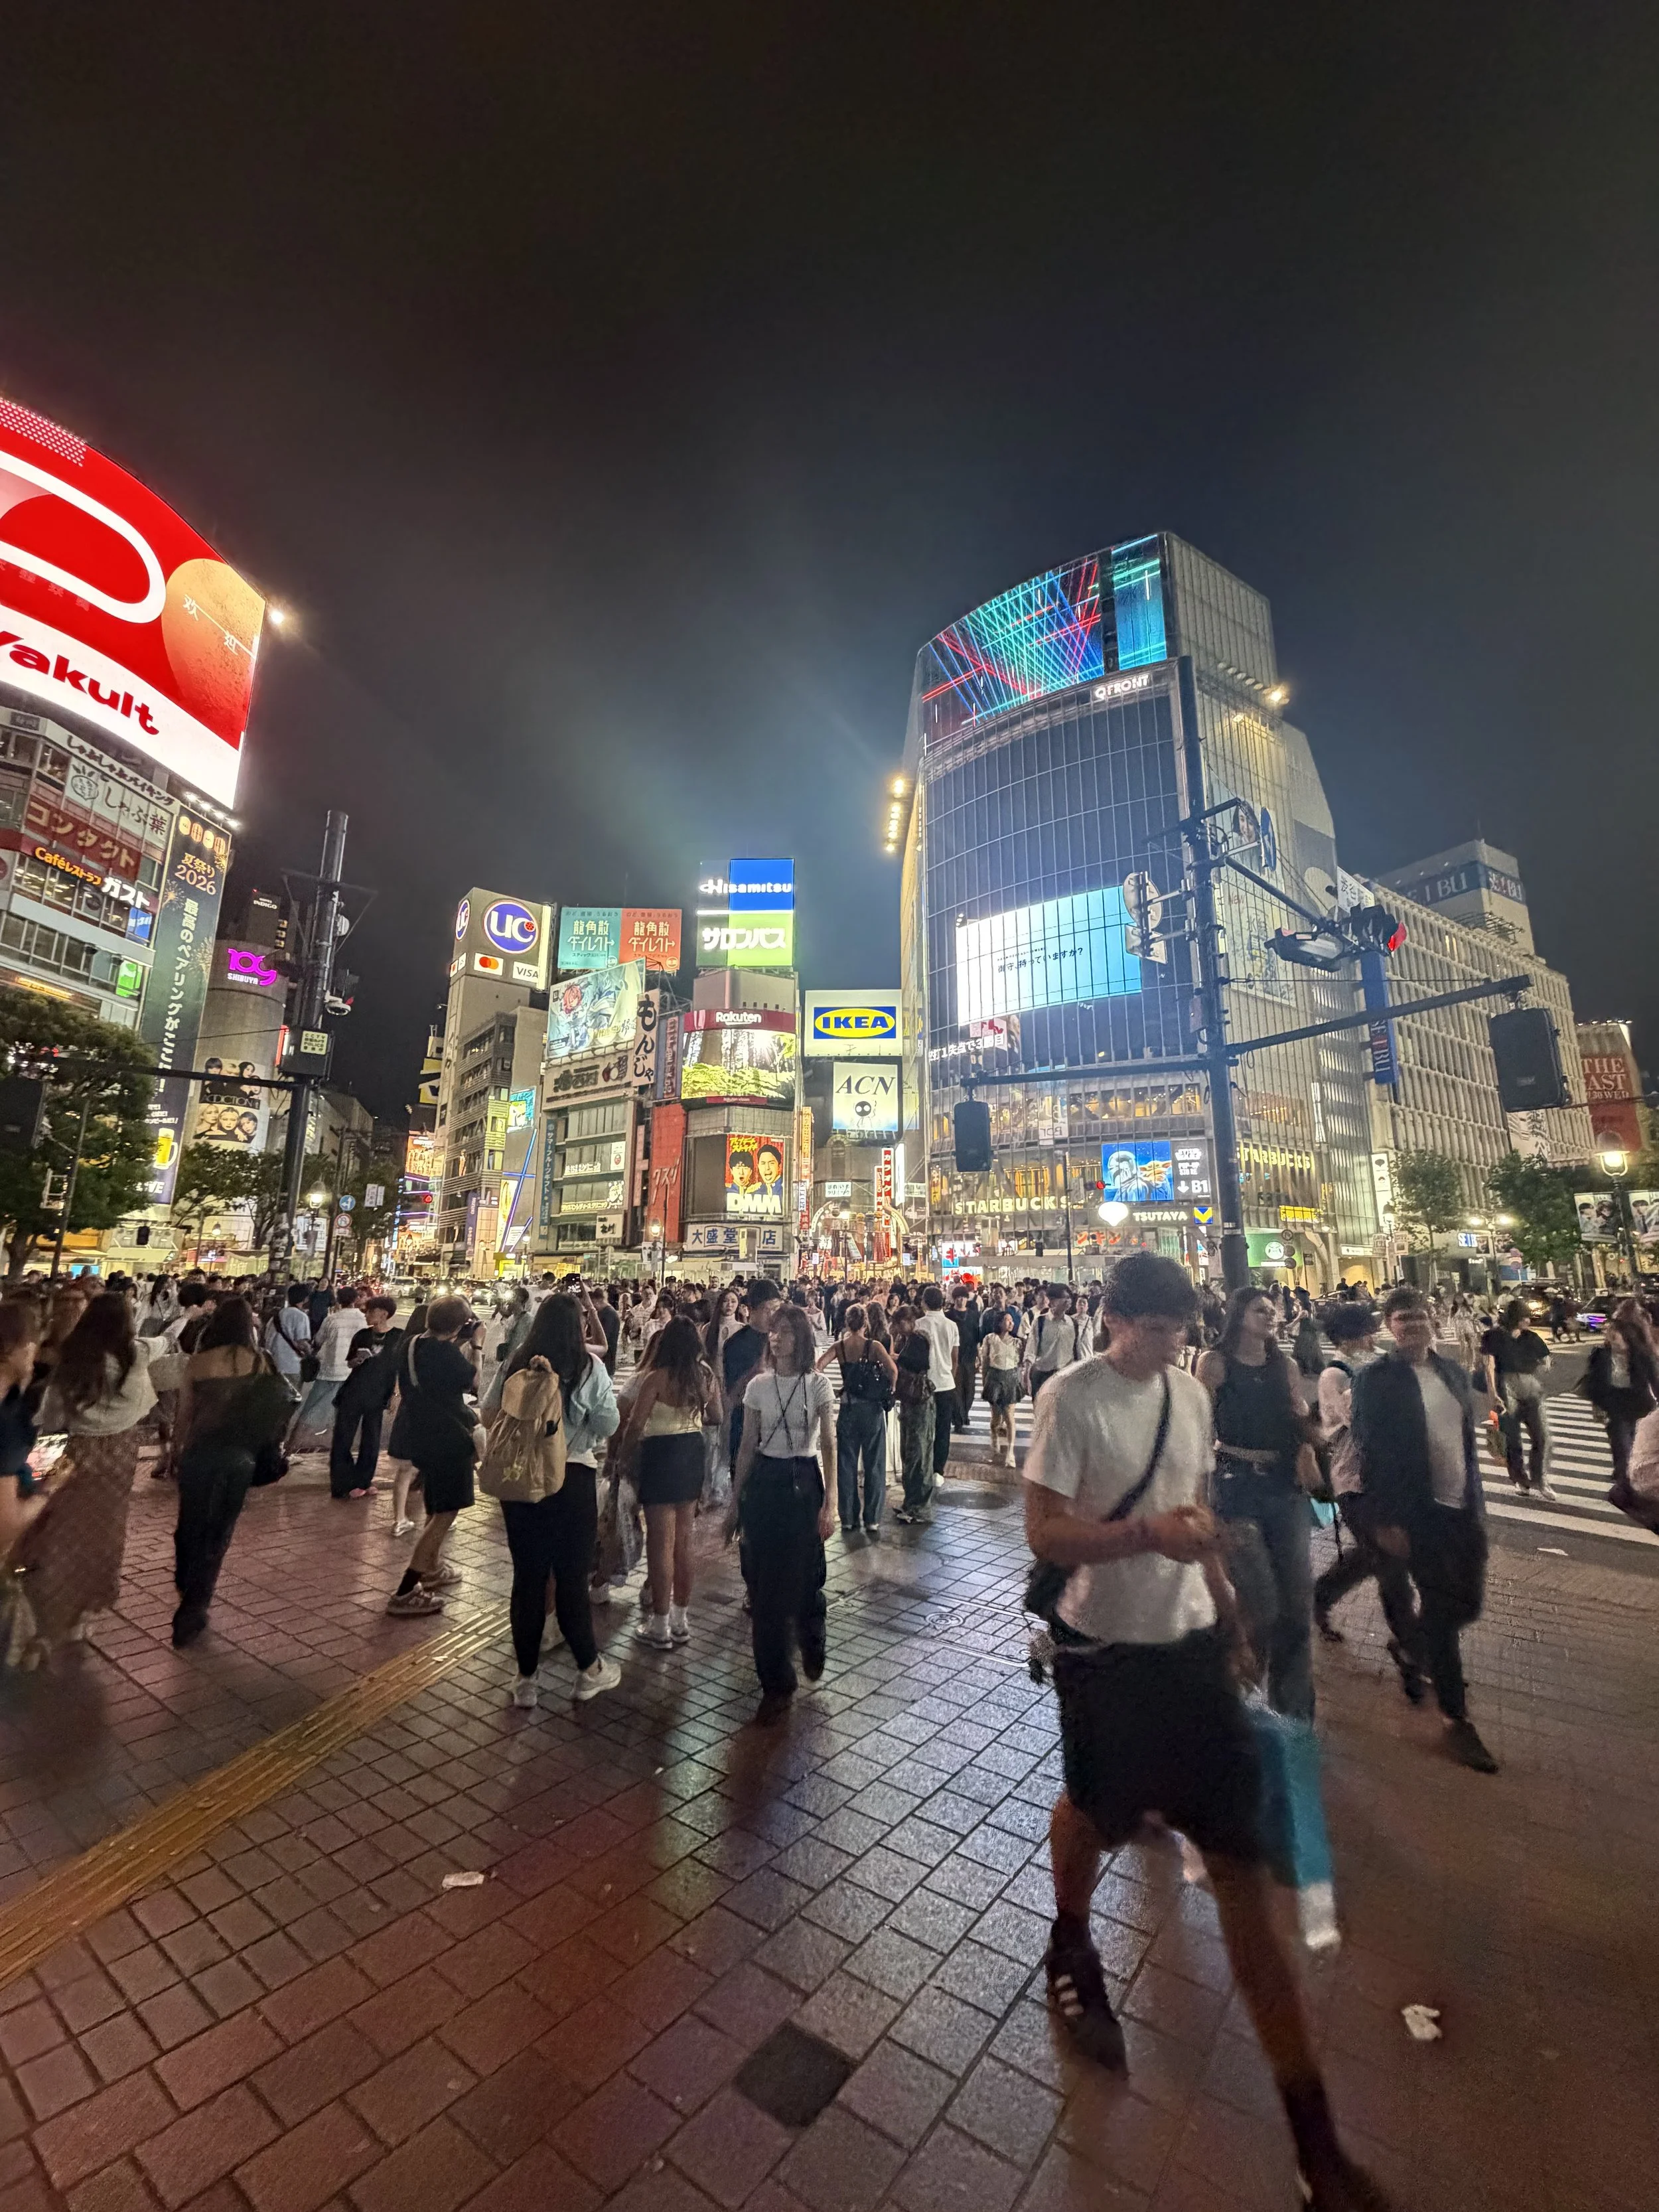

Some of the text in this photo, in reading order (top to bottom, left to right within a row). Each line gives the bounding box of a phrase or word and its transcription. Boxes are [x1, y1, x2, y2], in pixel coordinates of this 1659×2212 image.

[27, 801, 135, 869] コンタクト
[181, 852, 215, 879] 夏祭り
[175, 865, 217, 895] 2026
[700, 879, 792, 894] Hisamitsu
[102, 876, 150, 909] ガスト
[253, 899, 277, 910] INDIGO
[573, 920, 609, 936] 龍角散
[634, 921, 670, 936] 龍角散
[702, 927, 786, 950] サロンパス
[227, 948, 277, 987] 109
[516, 966, 539, 978] VISA
[227, 972, 259, 986] SHIBUYA
[715, 1011, 762, 1025] Rakuten
[822, 1016, 889, 1029] IKEA
[634, 995, 659, 1082] もんじゃ
[1581, 1058, 1624, 1074] THE
[835, 1074, 896, 1095] ACN
[1587, 1074, 1627, 1090] AST
[1191, 1180, 1208, 1193] B1
[727, 1192, 782, 1213] DMM
[955, 1196, 1070, 1215] STARBUCKS
[1133, 1211, 1188, 1222] TSUTAYA
[691, 1228, 776, 1246] 大盛堂店
